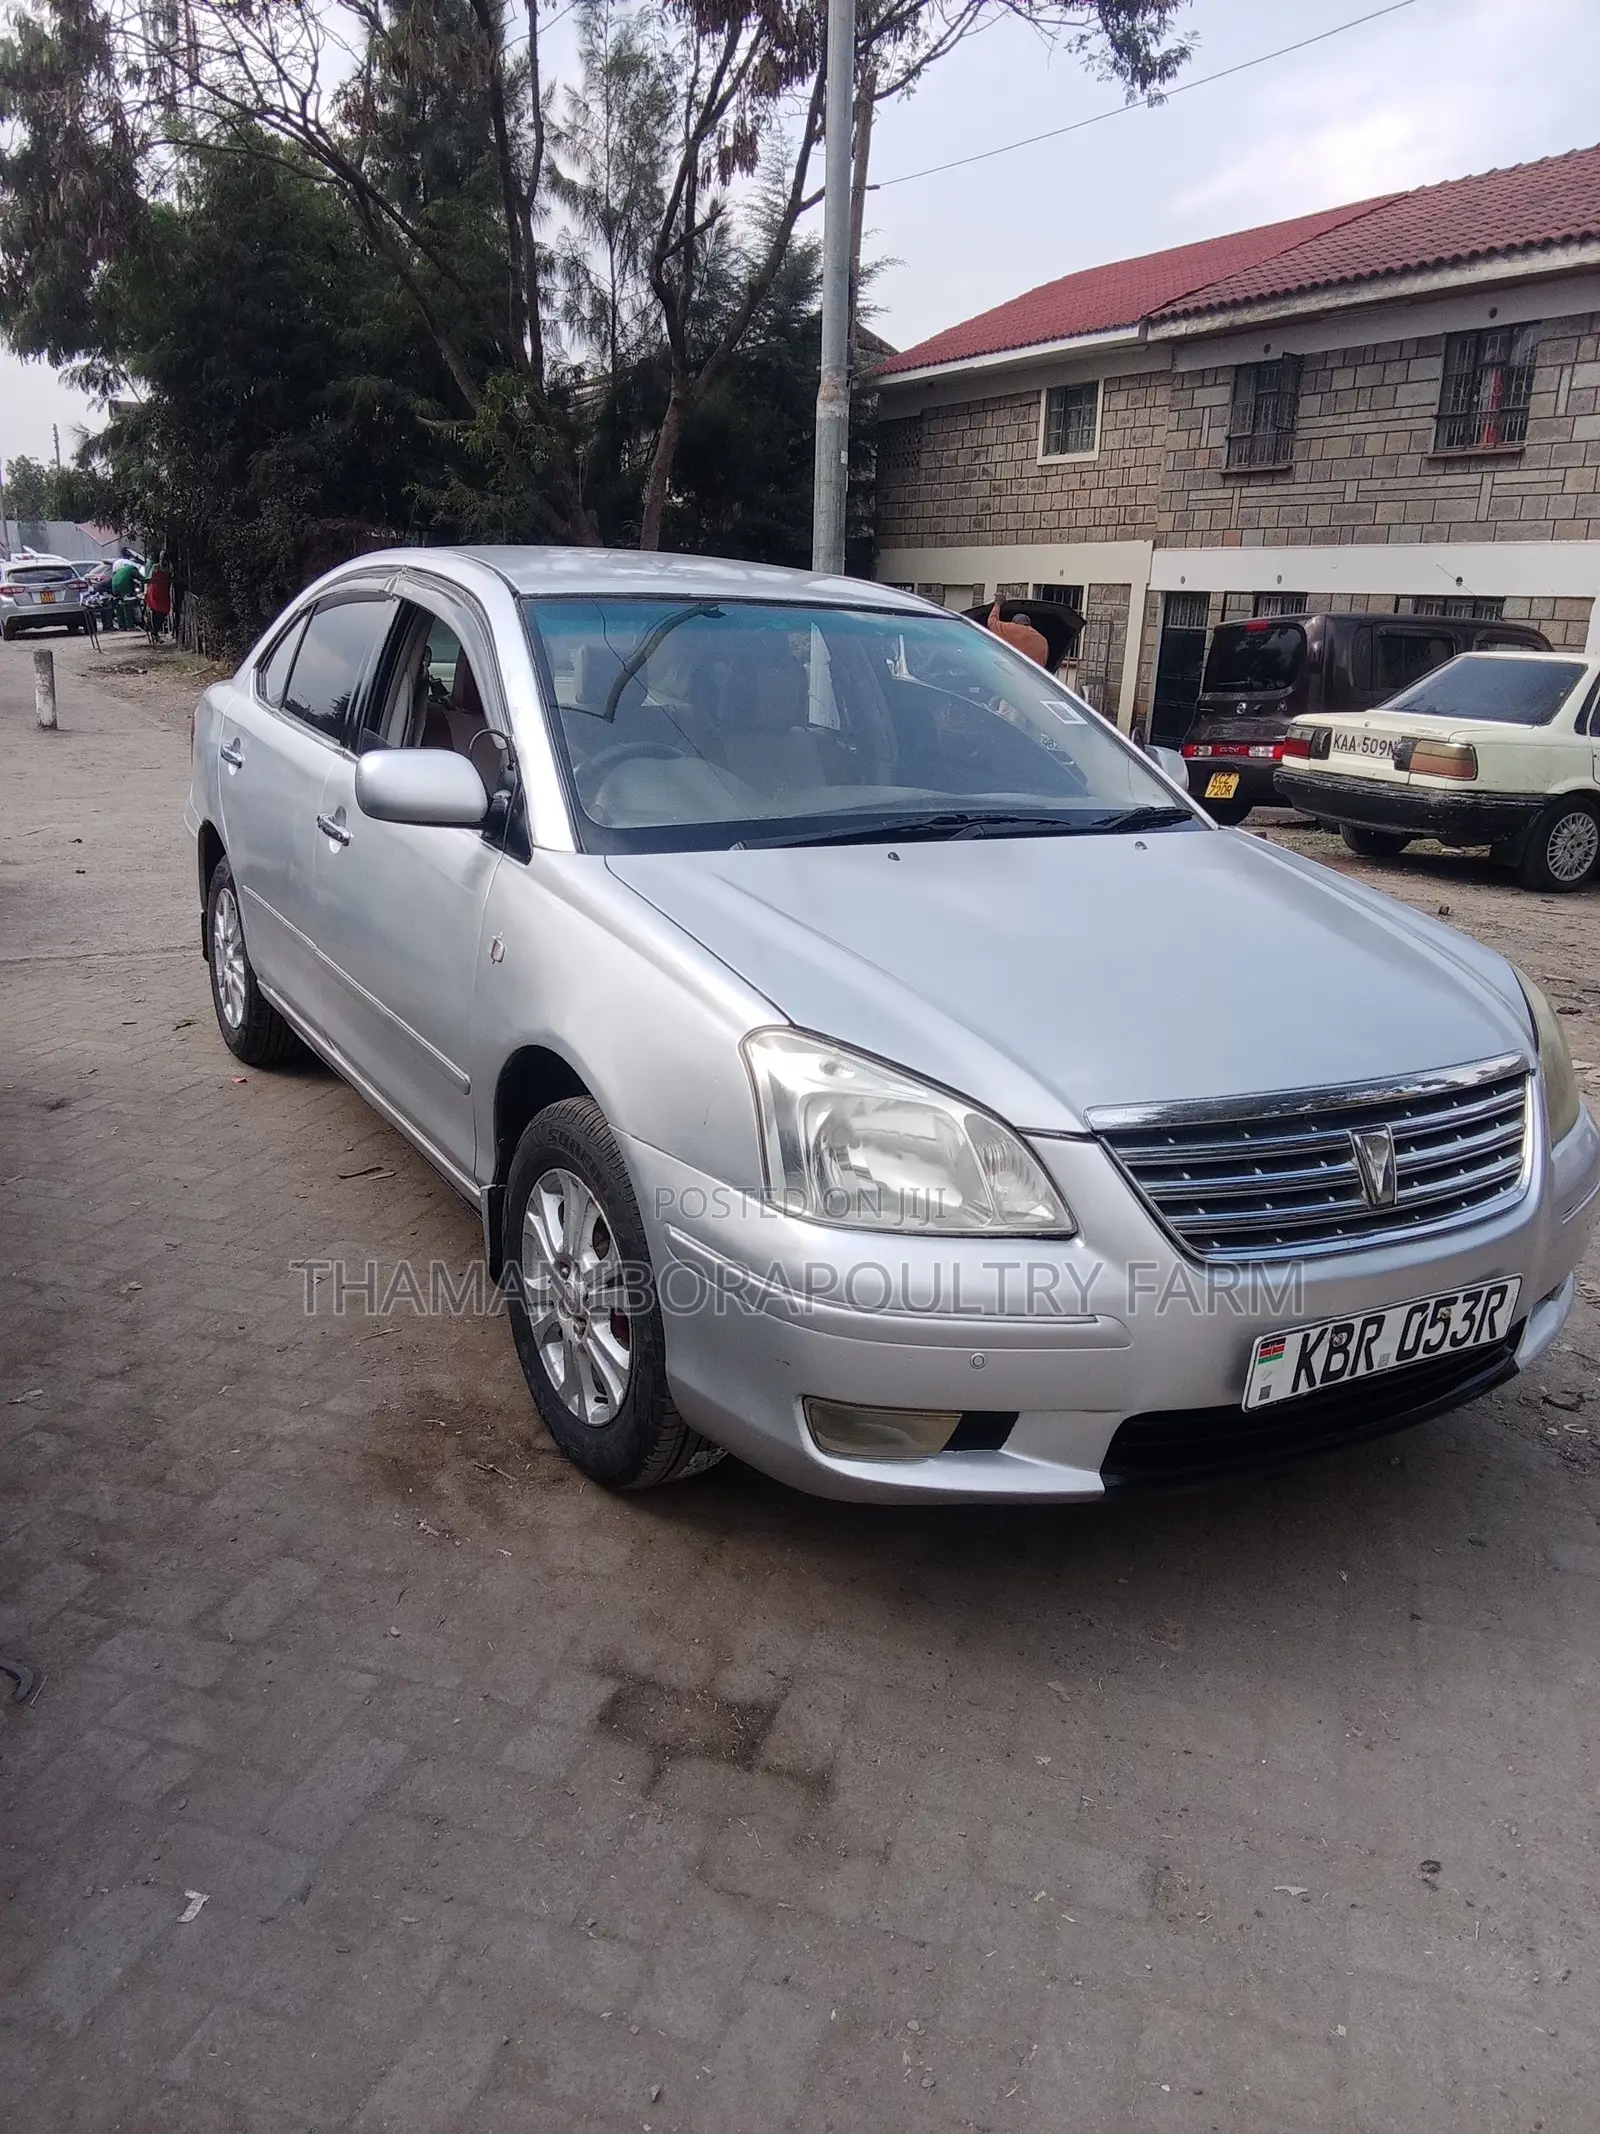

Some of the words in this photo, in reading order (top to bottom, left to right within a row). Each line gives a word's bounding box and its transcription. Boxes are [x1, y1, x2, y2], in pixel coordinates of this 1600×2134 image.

[1333, 734, 1356, 752] KAA
[1361, 736, 1396, 757] 509N
[1212, 772, 1231, 785] KCZ
[1207, 784, 1233, 797] 720R
[1291, 1314, 1386, 1393] KBR
[1395, 1285, 1509, 1362] 053R
